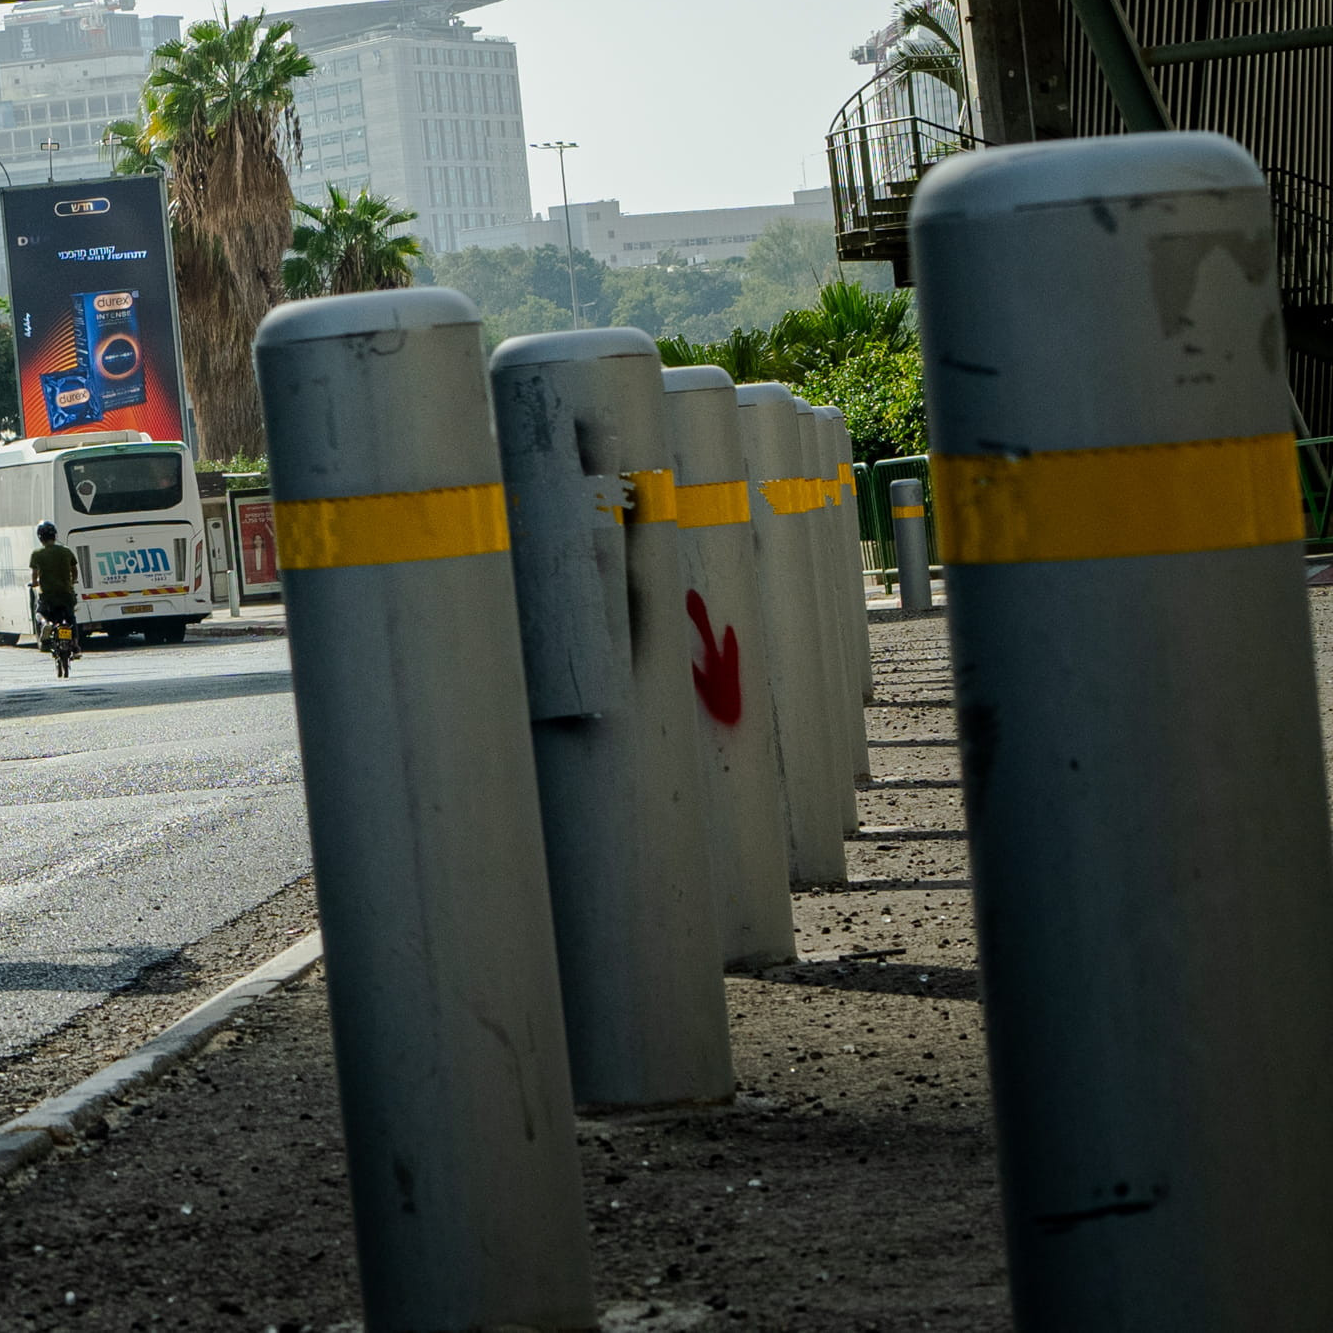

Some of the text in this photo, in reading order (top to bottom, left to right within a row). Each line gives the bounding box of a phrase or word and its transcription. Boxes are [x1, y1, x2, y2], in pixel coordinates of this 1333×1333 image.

[70, 202, 94, 213] חדש
[97, 296, 130, 308] durex
[59, 390, 87, 405] durex
[95, 547, 171, 576] תנופה
